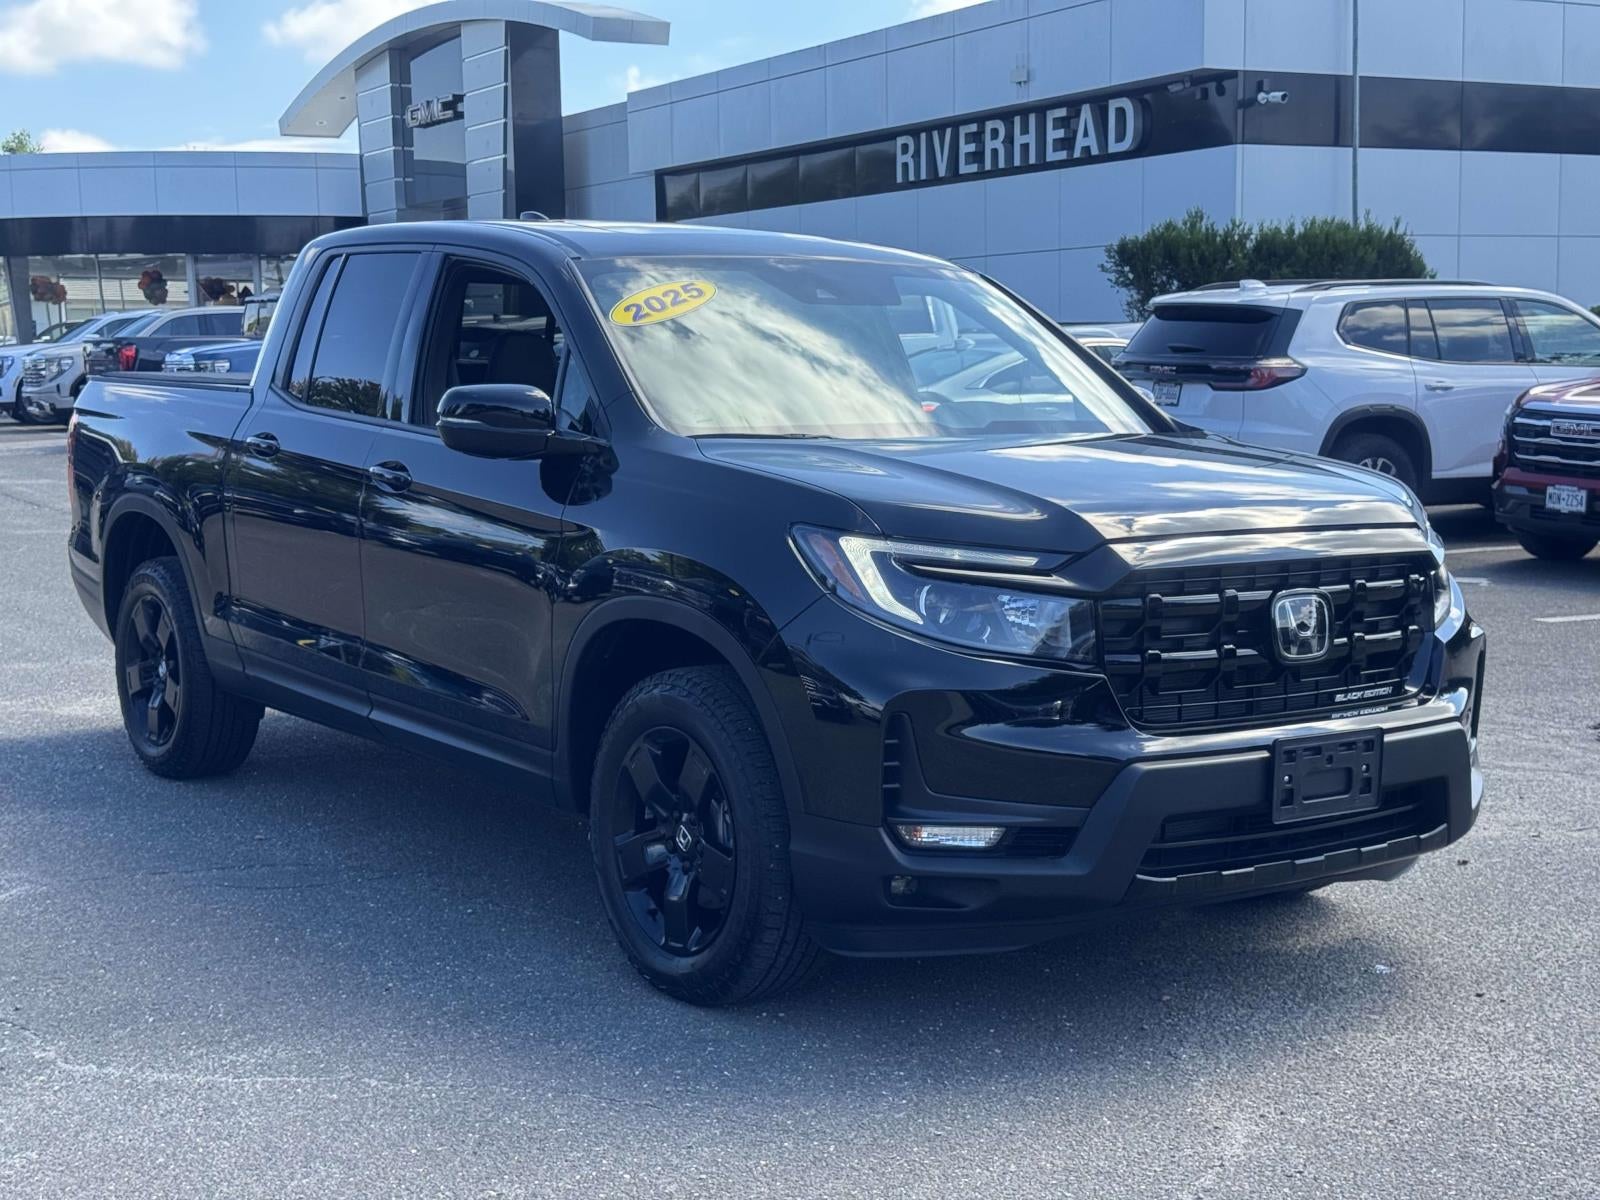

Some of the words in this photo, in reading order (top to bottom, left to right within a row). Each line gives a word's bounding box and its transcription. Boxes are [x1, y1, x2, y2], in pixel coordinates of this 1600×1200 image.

[405, 93, 454, 128] GMC
[896, 96, 1137, 183] RIVERHEAD
[624, 283, 705, 322] 2025
[1334, 691, 1363, 702] BLACK
[1363, 686, 1393, 698] EDITION
